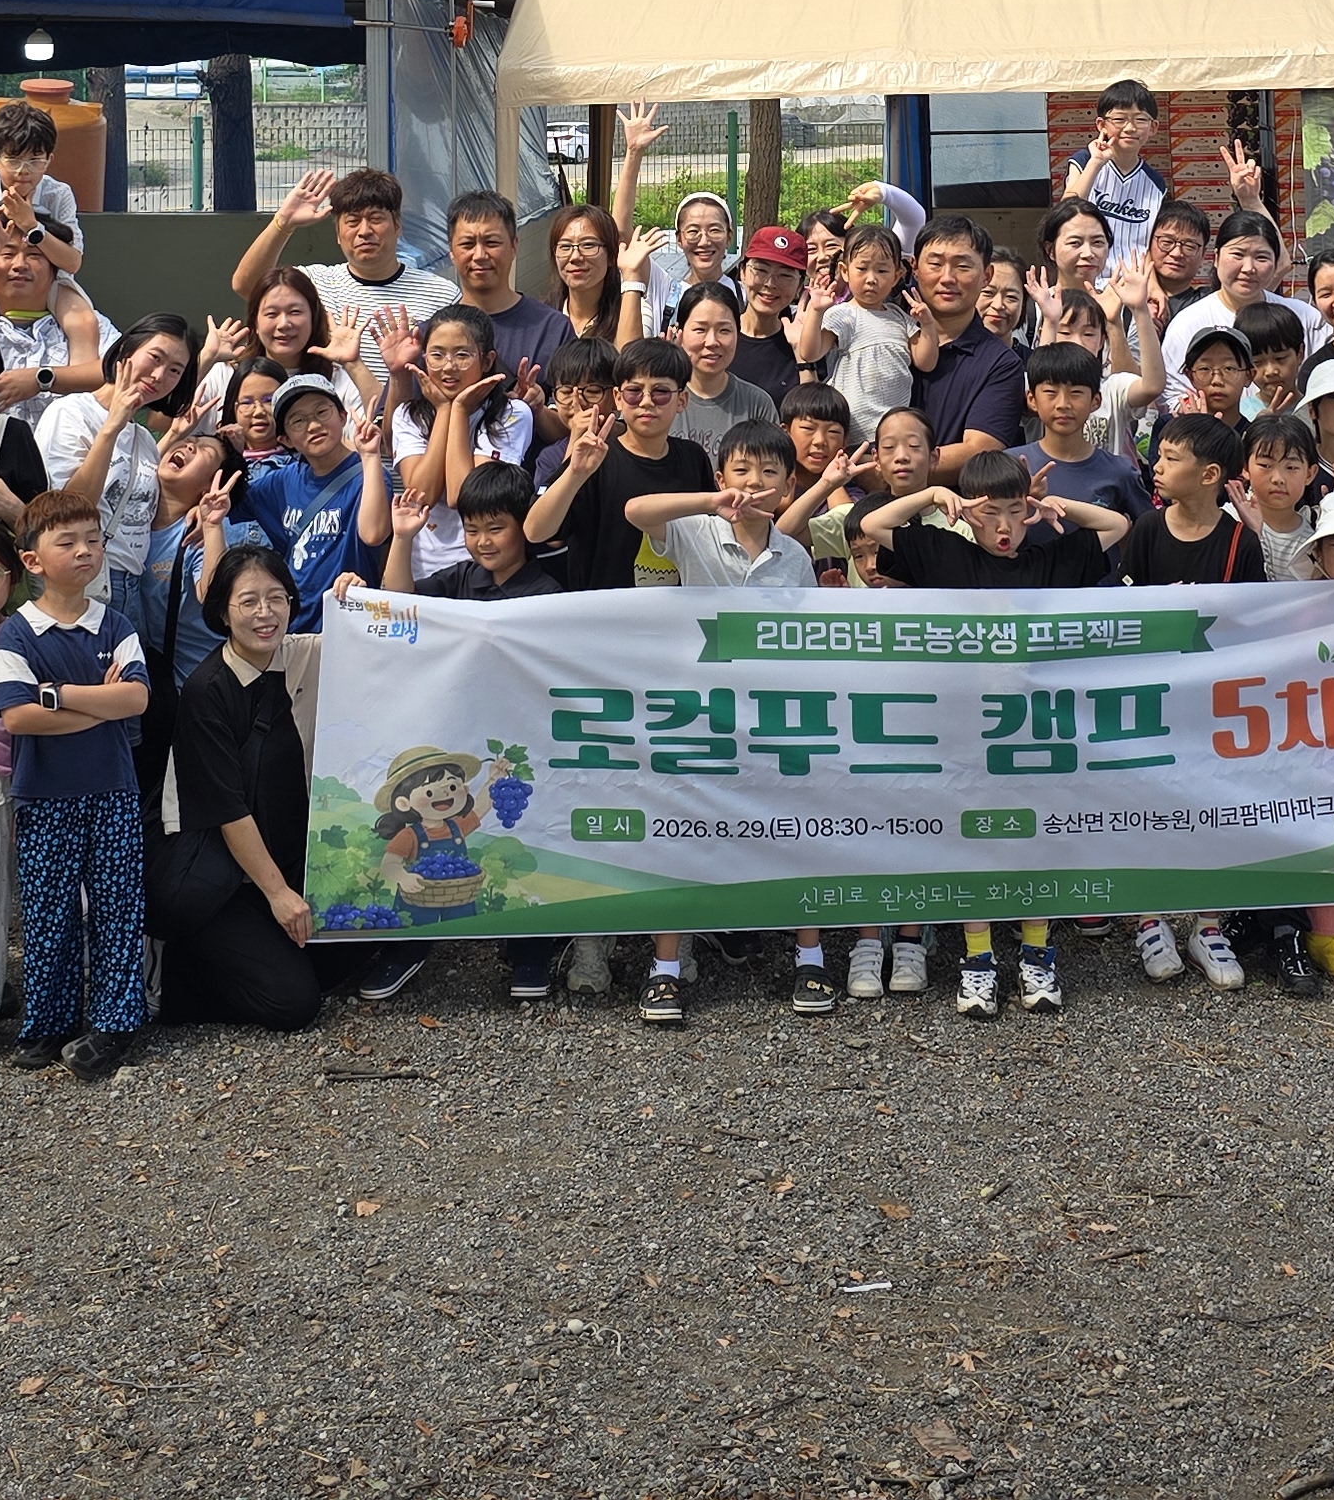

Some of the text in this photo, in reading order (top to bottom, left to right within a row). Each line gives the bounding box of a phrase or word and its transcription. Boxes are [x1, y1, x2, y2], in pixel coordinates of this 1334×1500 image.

[1093, 187, 1151, 219] Yankees
[339, 600, 391, 621] 모두의 행복
[388, 621, 418, 644] 화성
[756, 619, 1143, 655] 2026년 도농상생 프로젝트
[548, 687, 943, 776] 로컬푸드
[981, 681, 1176, 776] 캠프
[1042, 811, 1104, 835] 송산면
[1108, 808, 1196, 833] 진아농원,
[799, 878, 1115, 913] 신뢰로 완성되는 화성의 식탁
